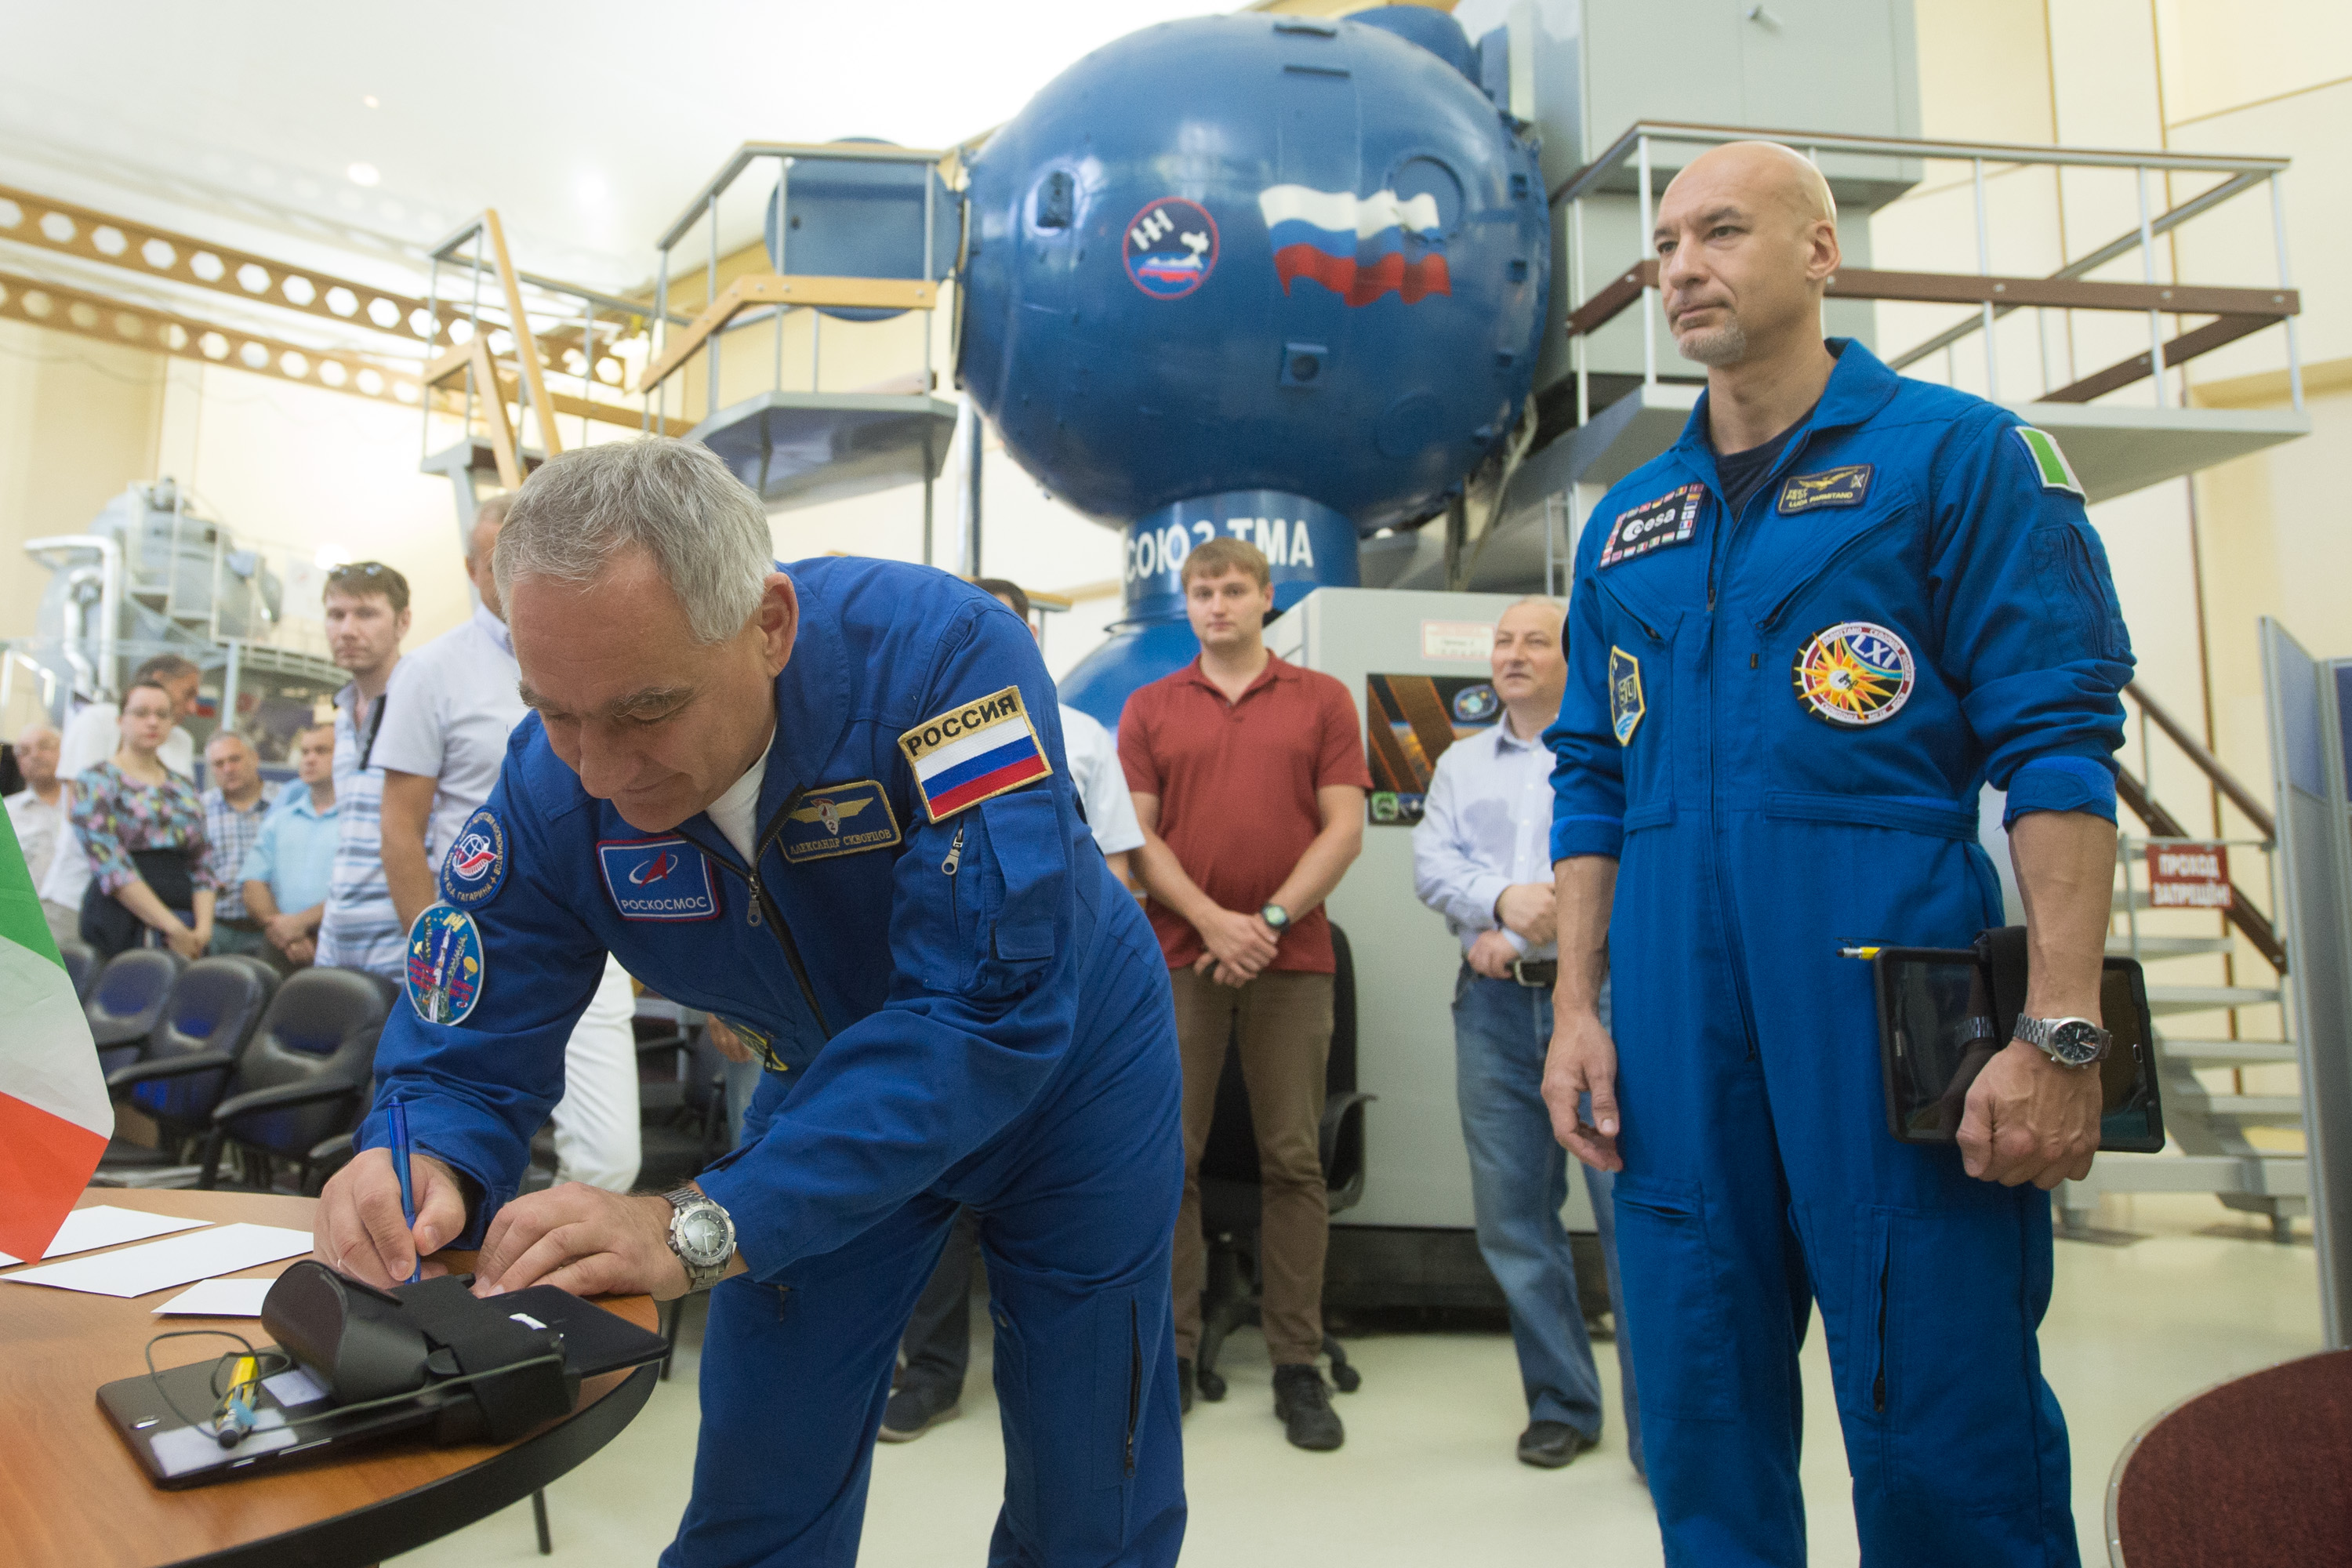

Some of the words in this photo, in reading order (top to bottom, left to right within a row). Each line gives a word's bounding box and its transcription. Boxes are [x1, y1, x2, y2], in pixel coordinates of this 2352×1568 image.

[1643, 508, 1676, 532] esa
[1226, 517, 1315, 568] ТМА
[1851, 633, 1897, 670] LXI
[906, 695, 1018, 757] РОССИЯ
[790, 838, 840, 855] АЛЕКСАНДР
[843, 829, 892, 846] СКВОРЦОВ
[2159, 854, 2220, 879] ПРОХОД
[457, 884, 493, 902] ГАГАРИНА
[621, 896, 707, 910] РОСКОСМОС
